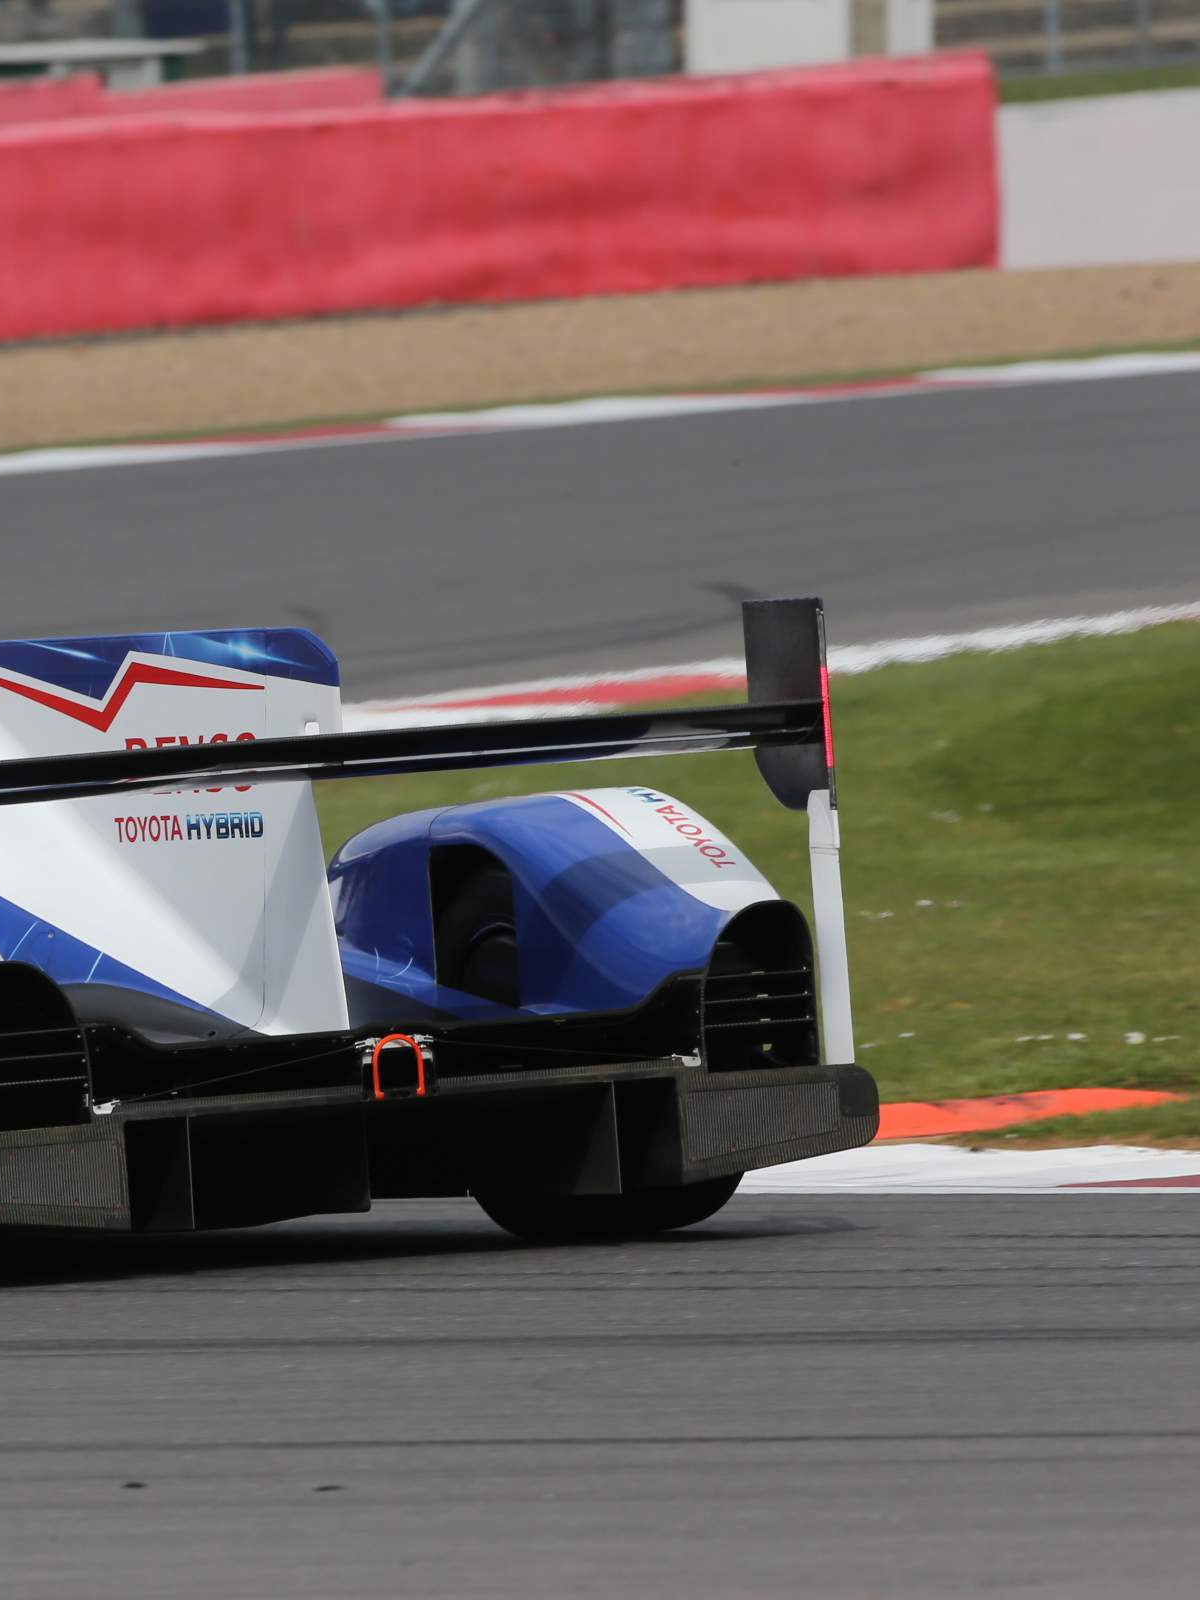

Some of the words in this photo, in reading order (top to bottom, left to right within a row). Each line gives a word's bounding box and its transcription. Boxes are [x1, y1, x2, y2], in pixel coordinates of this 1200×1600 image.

[114, 815, 183, 843] TOYOTA
[186, 811, 264, 841] HYBRID
[656, 804, 737, 869] TOYOTA
